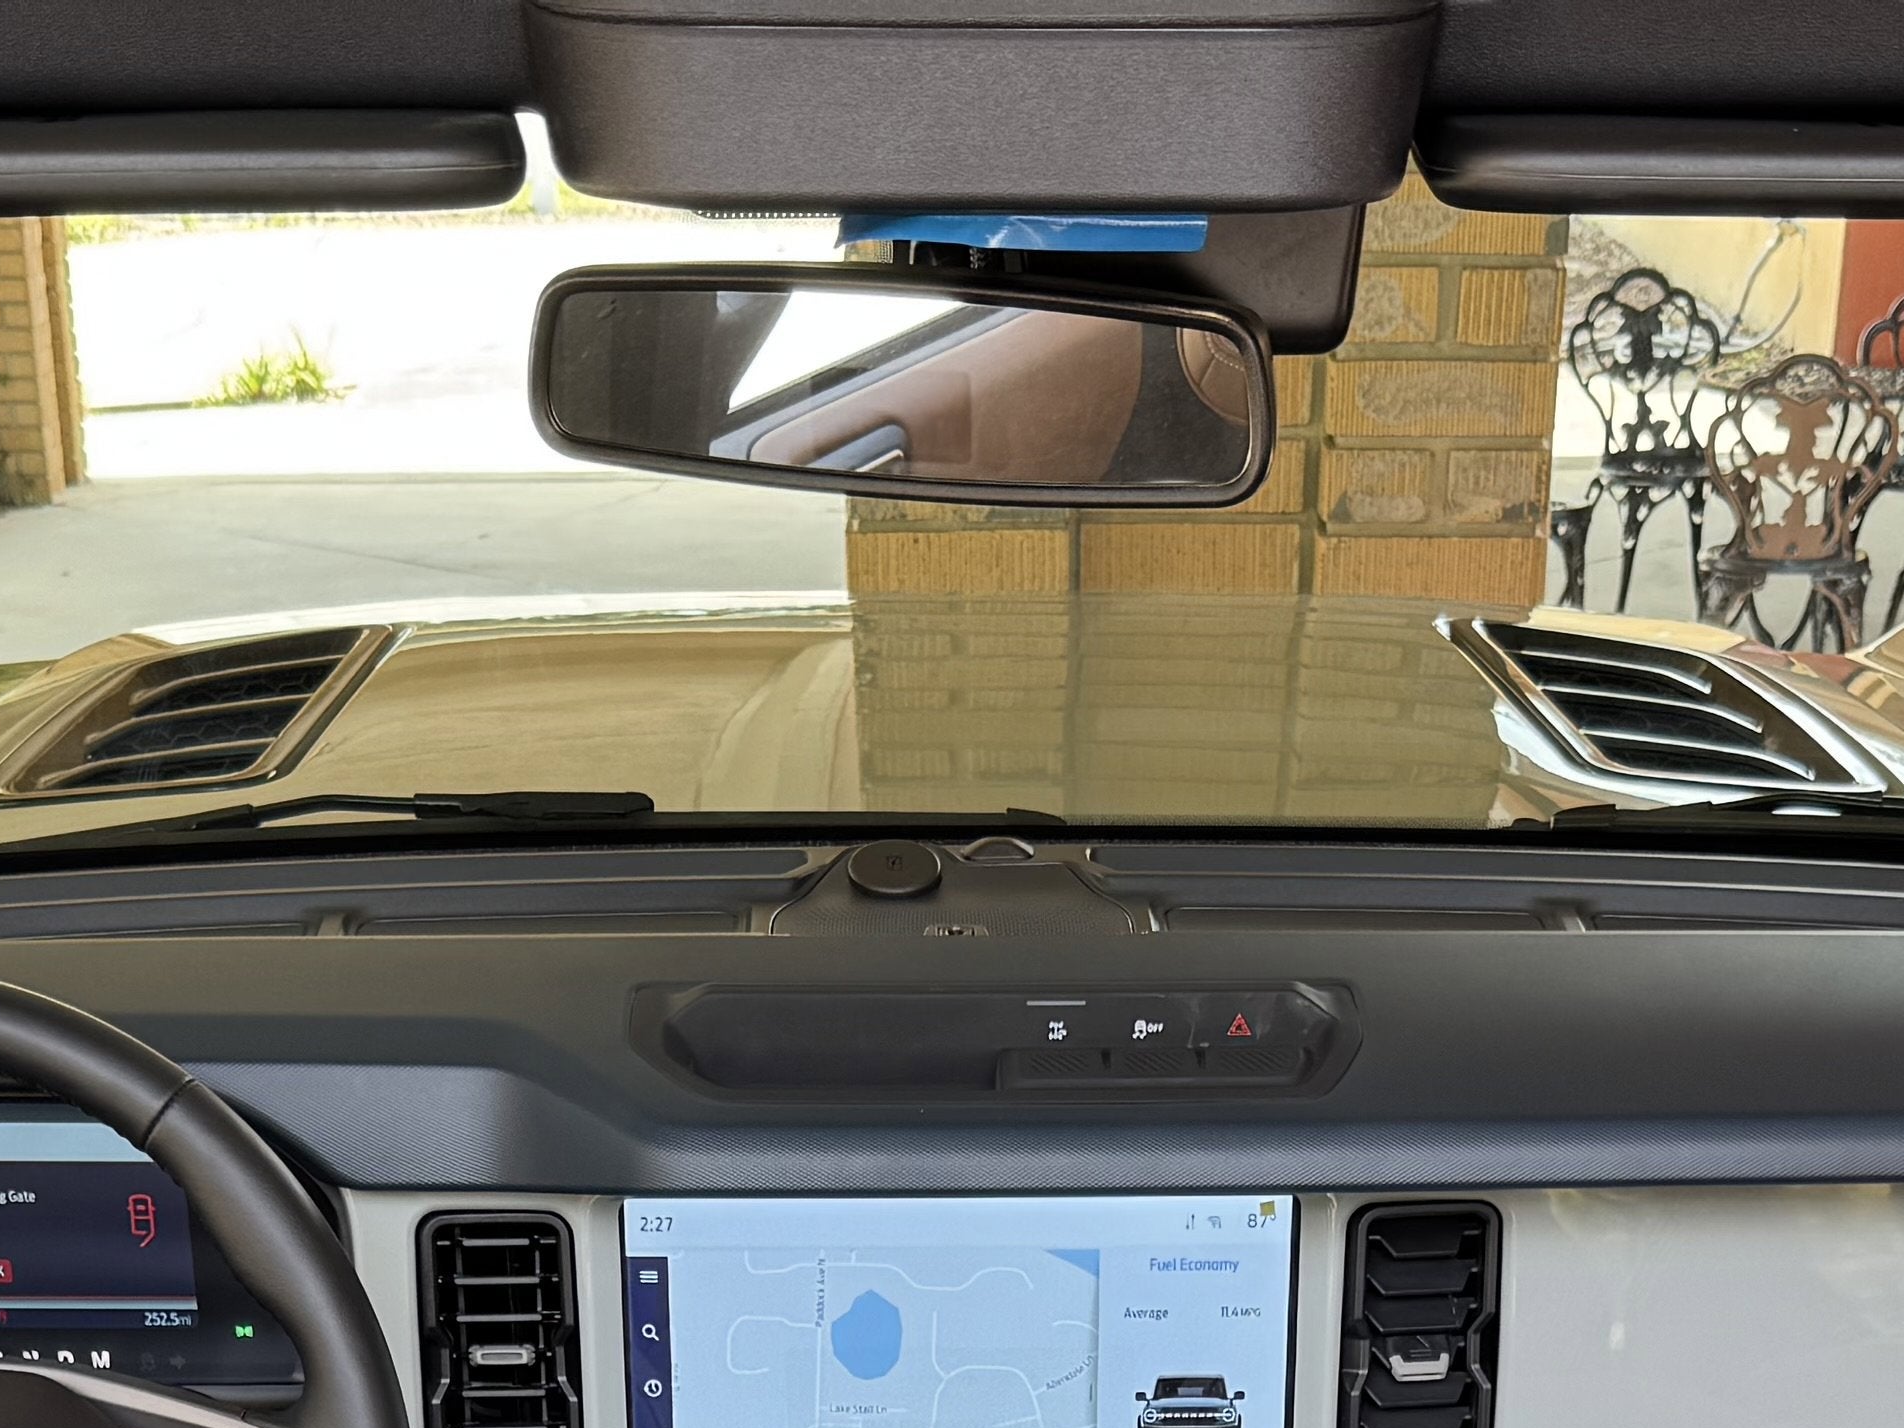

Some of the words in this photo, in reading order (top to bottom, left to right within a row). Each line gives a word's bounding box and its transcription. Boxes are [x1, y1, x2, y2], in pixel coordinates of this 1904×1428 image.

[8, 1190, 36, 1203] Gate
[640, 1217, 673, 1232] 2:27
[1149, 1258, 1177, 1272] Fuel
[1180, 1258, 1240, 1273] Economy
[1124, 1307, 1169, 1321] Average
[91, 1350, 111, 1369] M
[829, 1404, 849, 1414] Lake
